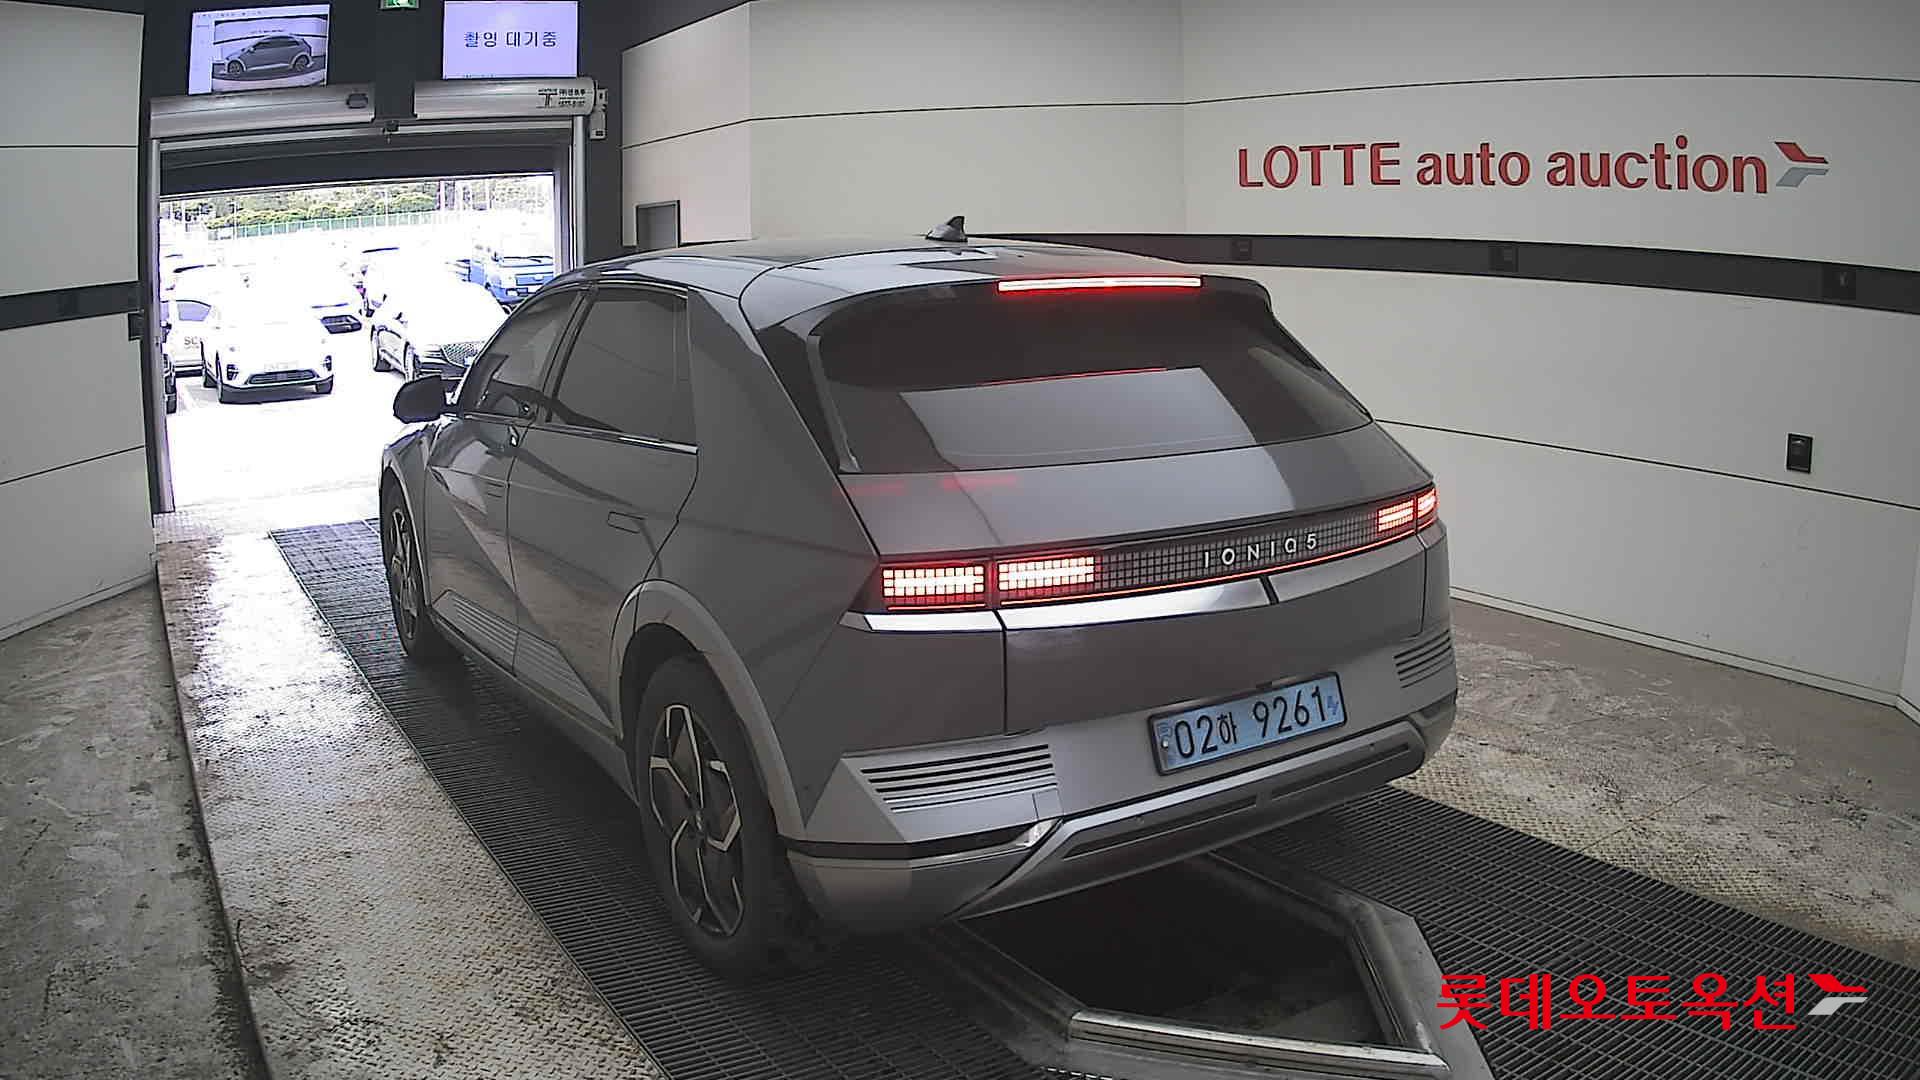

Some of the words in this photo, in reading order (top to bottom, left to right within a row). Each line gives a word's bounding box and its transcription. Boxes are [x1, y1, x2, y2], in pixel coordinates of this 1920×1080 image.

[506, 31, 557, 48] 대기중
[1238, 142, 1401, 188] LOTTE
[1416, 142, 1531, 186] auto
[1546, 135, 1767, 194] auction
[1204, 537, 1297, 569] IONIQ
[1306, 532, 1317, 550] 5
[1174, 711, 1238, 759] 02하
[1252, 685, 1327, 739] 9261
